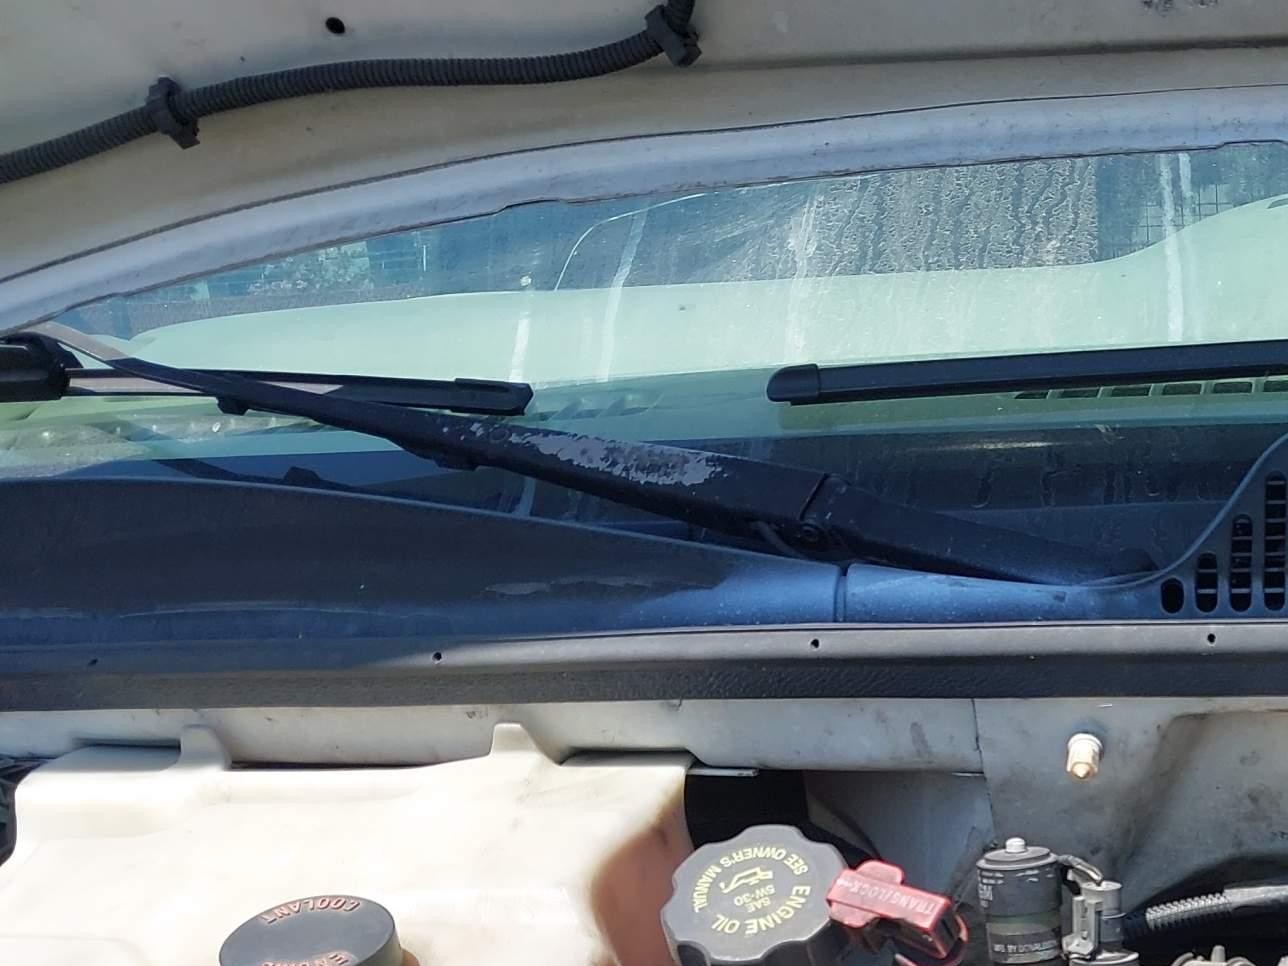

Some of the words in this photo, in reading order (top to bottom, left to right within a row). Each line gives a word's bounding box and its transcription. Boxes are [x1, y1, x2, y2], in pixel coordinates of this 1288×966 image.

[719, 846, 787, 868] OWNER'S
[783, 853, 809, 876] SEE
[692, 864, 723, 914] MANUAL
[733, 884, 776, 907] 5W-30
[261, 896, 362, 925] COOLANT
[743, 885, 812, 935] ENGINE
[744, 896, 771, 913] SAE
[711, 913, 741, 934] OIL
